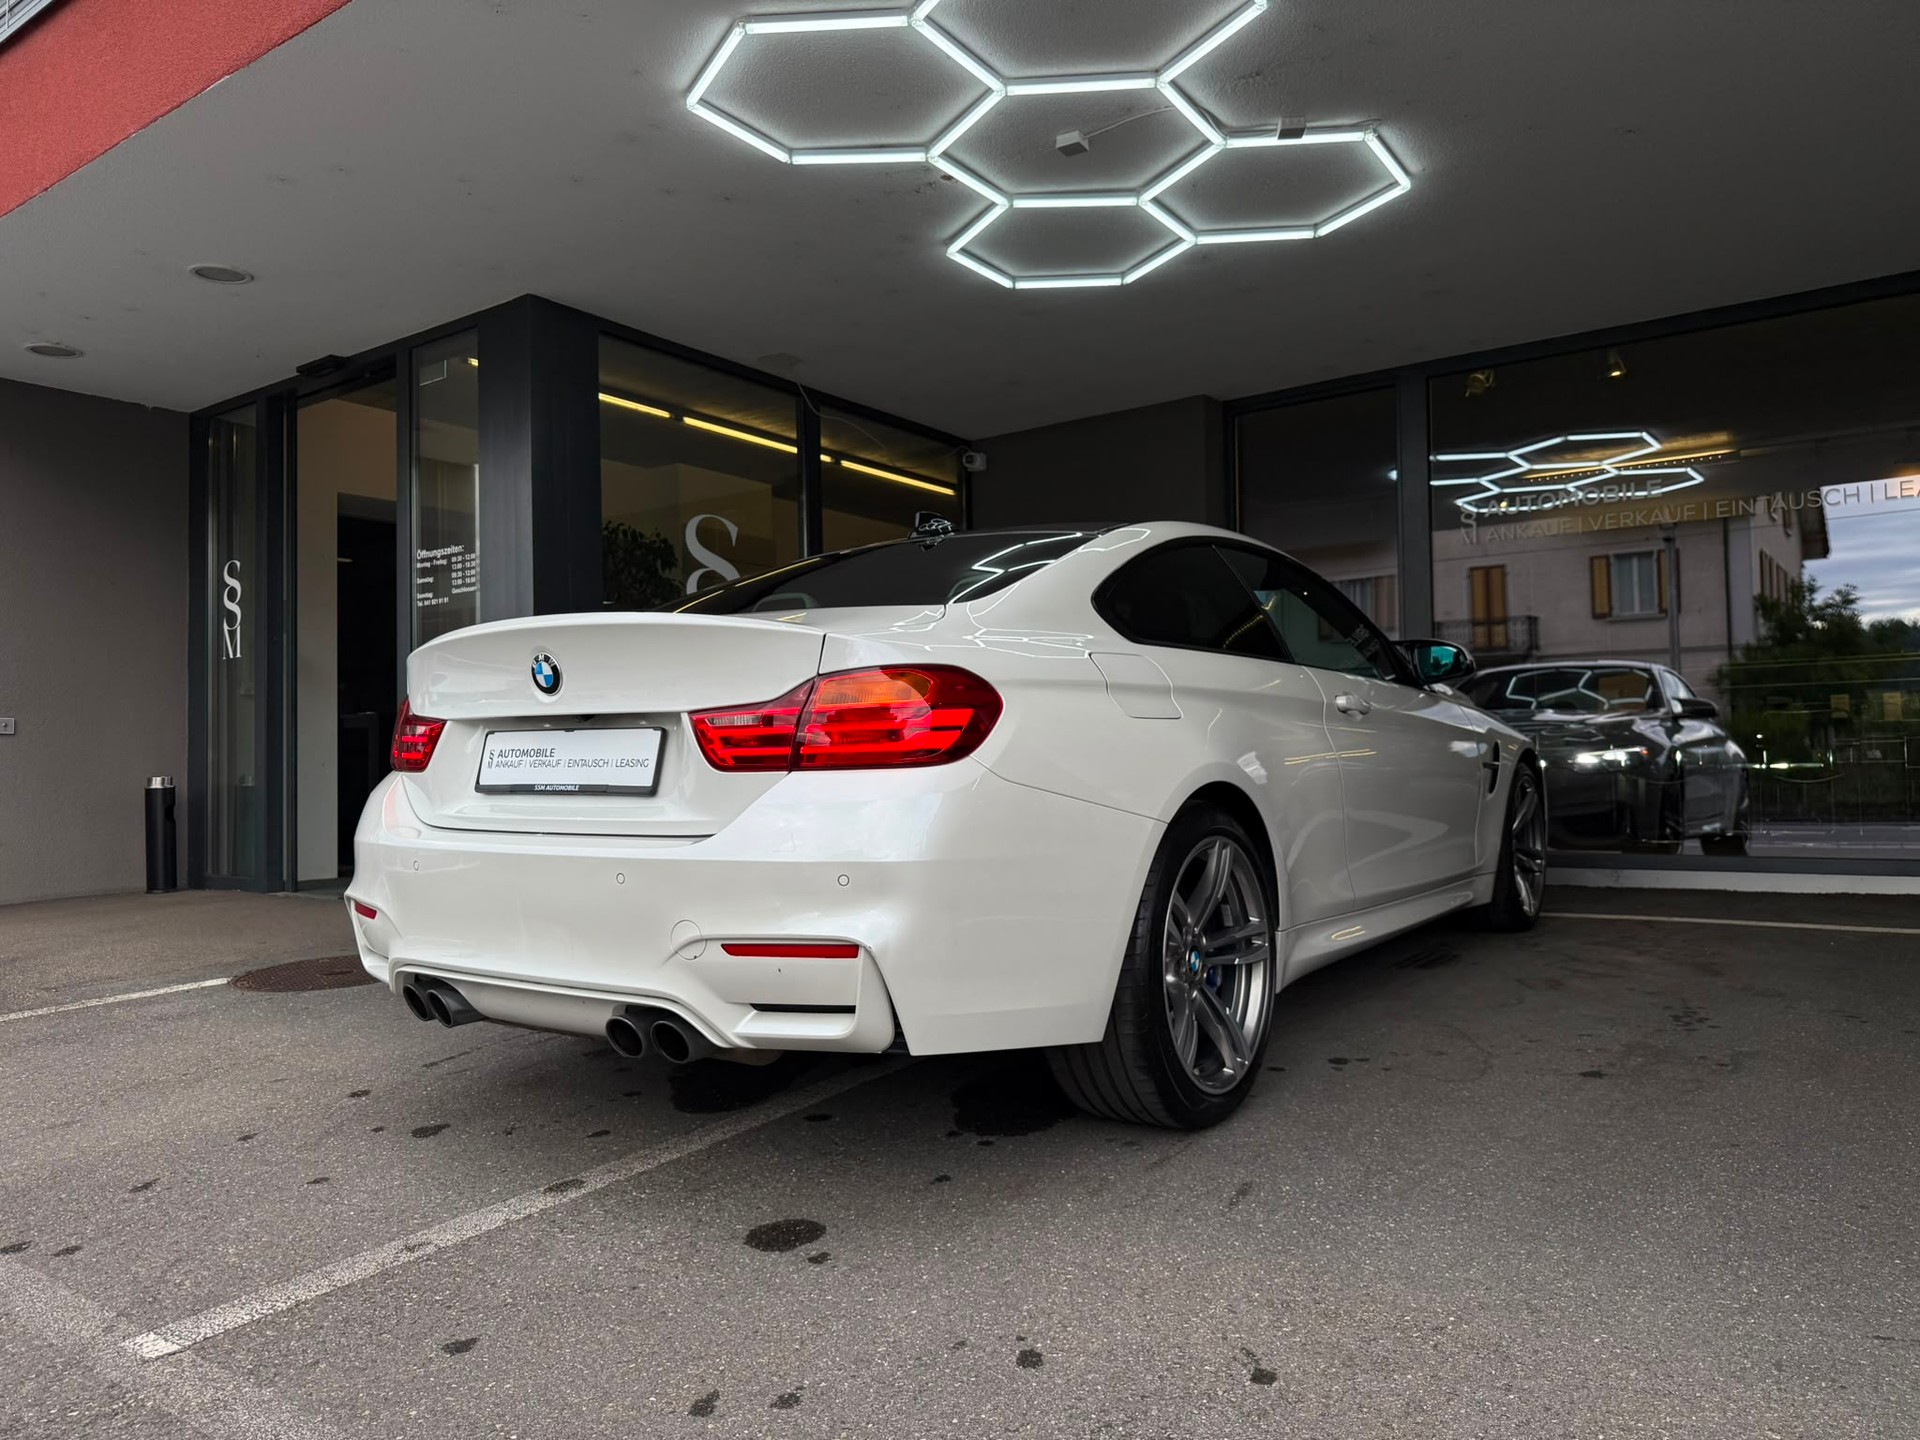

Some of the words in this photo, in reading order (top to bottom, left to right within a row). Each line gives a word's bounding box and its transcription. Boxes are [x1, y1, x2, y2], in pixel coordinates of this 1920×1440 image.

[1484, 479, 1663, 517] AUTOMOBILE
[1485, 516, 1573, 542] ANKAUF
[1590, 504, 1696, 531] VERKAUF
[1716, 485, 1860, 518] EINTAUSCH
[1884, 479, 1920, 500] LE
[417, 545, 464, 559] Öffnungszeiten:
[497, 748, 556, 758] AUTOMOBILE
[495, 759, 524, 768] ANKAUF
[529, 759, 562, 768] VERKAUF
[567, 758, 609, 768] EINTAUSCH
[615, 758, 650, 768] LEASING
